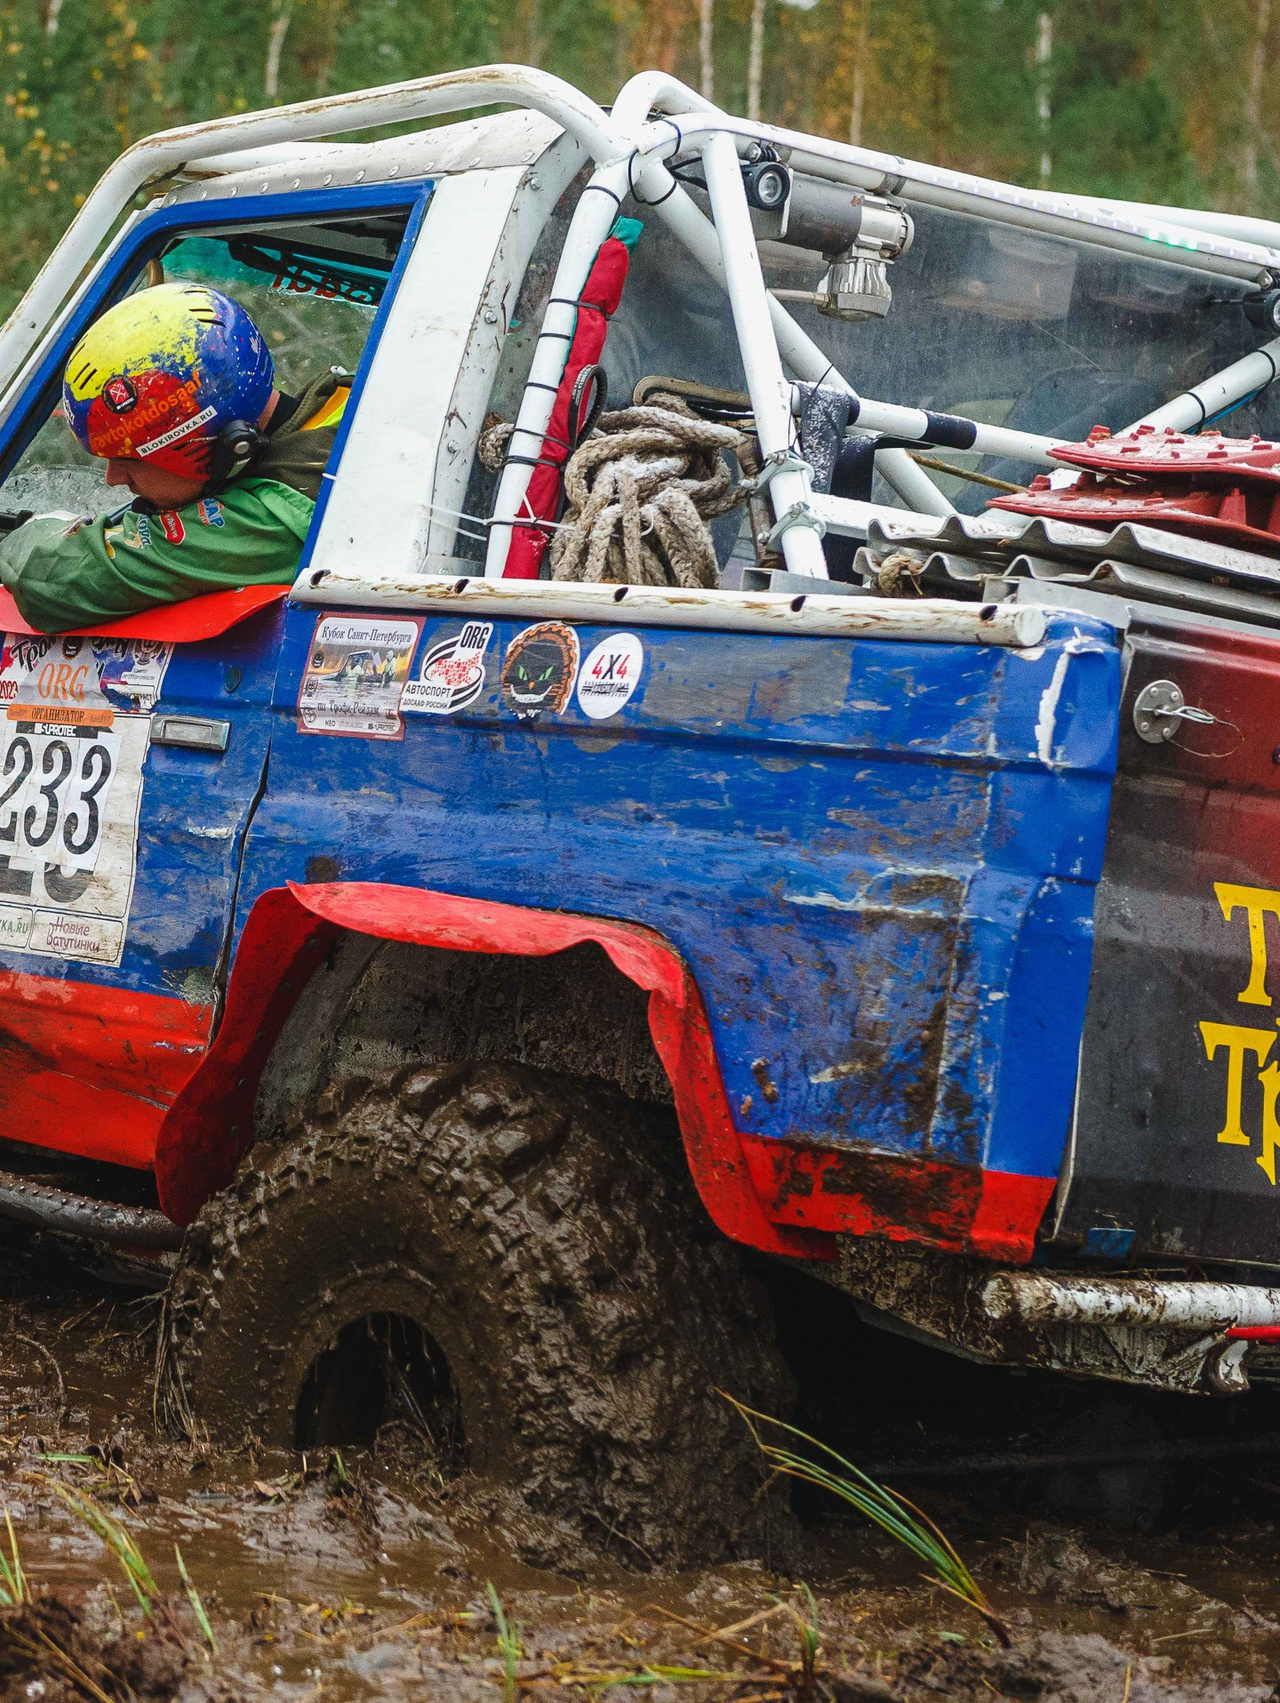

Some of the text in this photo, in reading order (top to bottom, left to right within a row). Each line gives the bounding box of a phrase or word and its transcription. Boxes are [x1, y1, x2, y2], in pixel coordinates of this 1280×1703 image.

[140, 408, 214, 455] BLOKIROVKA.RU
[321, 625, 413, 645] Кубок Санкт-Петербурга
[460, 625, 490, 650] ORG
[38, 662, 89, 702] ORG
[406, 684, 452, 698] АВТОСПОРТ
[402, 697, 449, 710] ДОСААФ РОССИИ
[31, 707, 85, 723] ОРГАНИЗАТОР
[50, 916, 91, 937] Новые
[47, 927, 101, 953] Ватутинки
